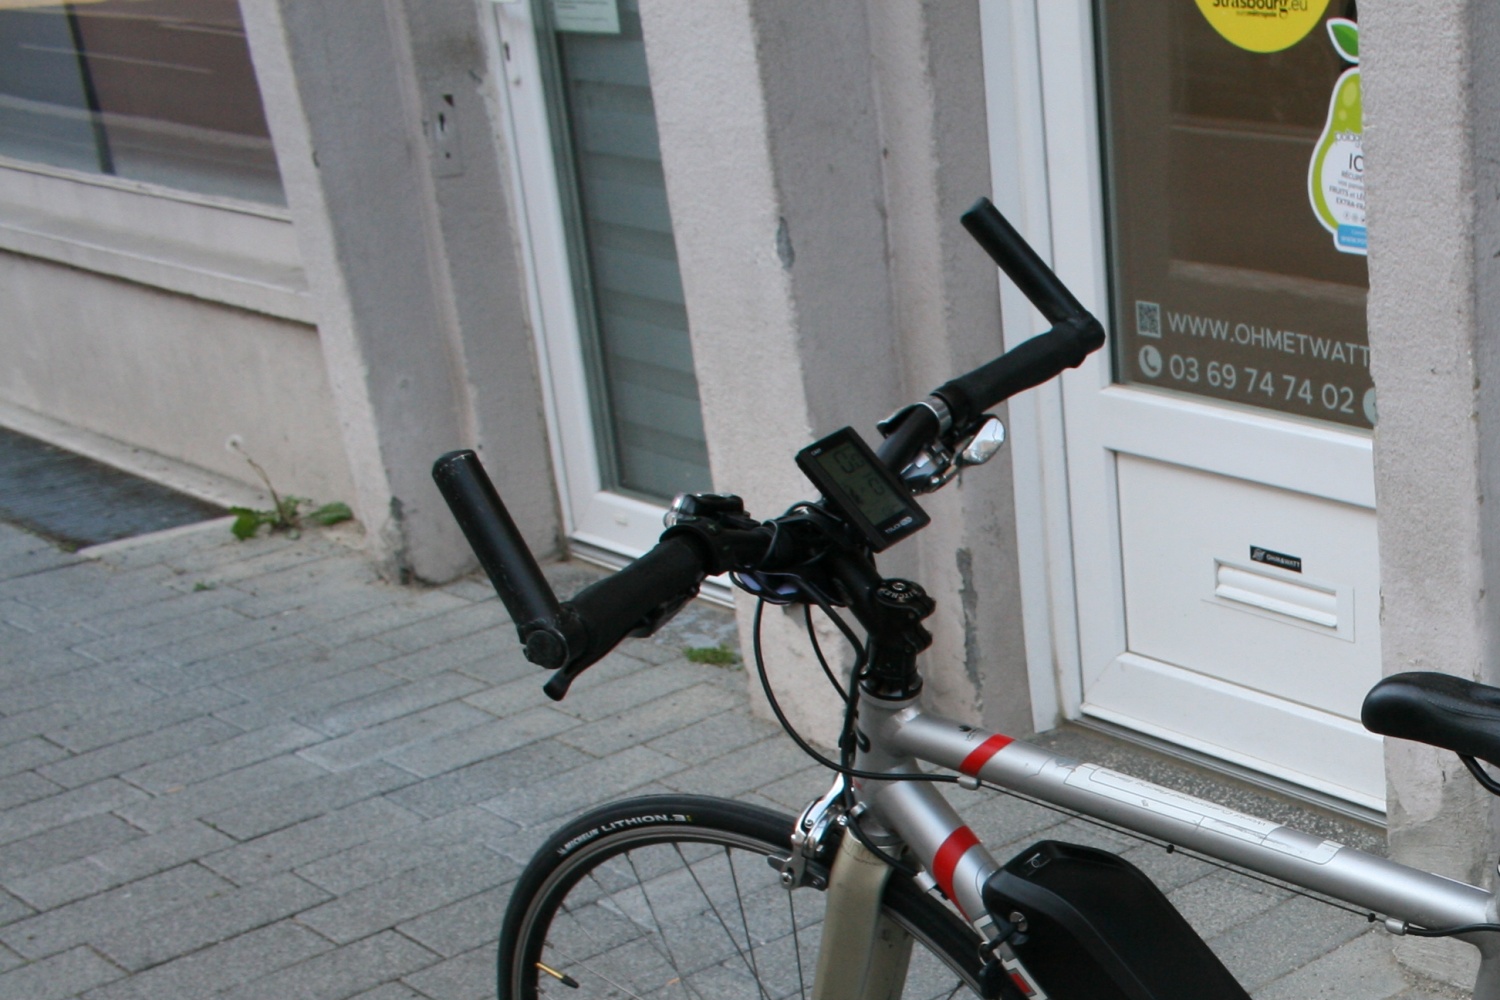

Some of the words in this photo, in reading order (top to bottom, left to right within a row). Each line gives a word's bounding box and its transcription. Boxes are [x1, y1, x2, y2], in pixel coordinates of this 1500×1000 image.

[1169, 354, 1200, 382] 03
[1207, 361, 1237, 390] 69
[1245, 367, 1275, 398] 74
[1282, 374, 1313, 404] 74
[1321, 382, 1355, 414] 02
